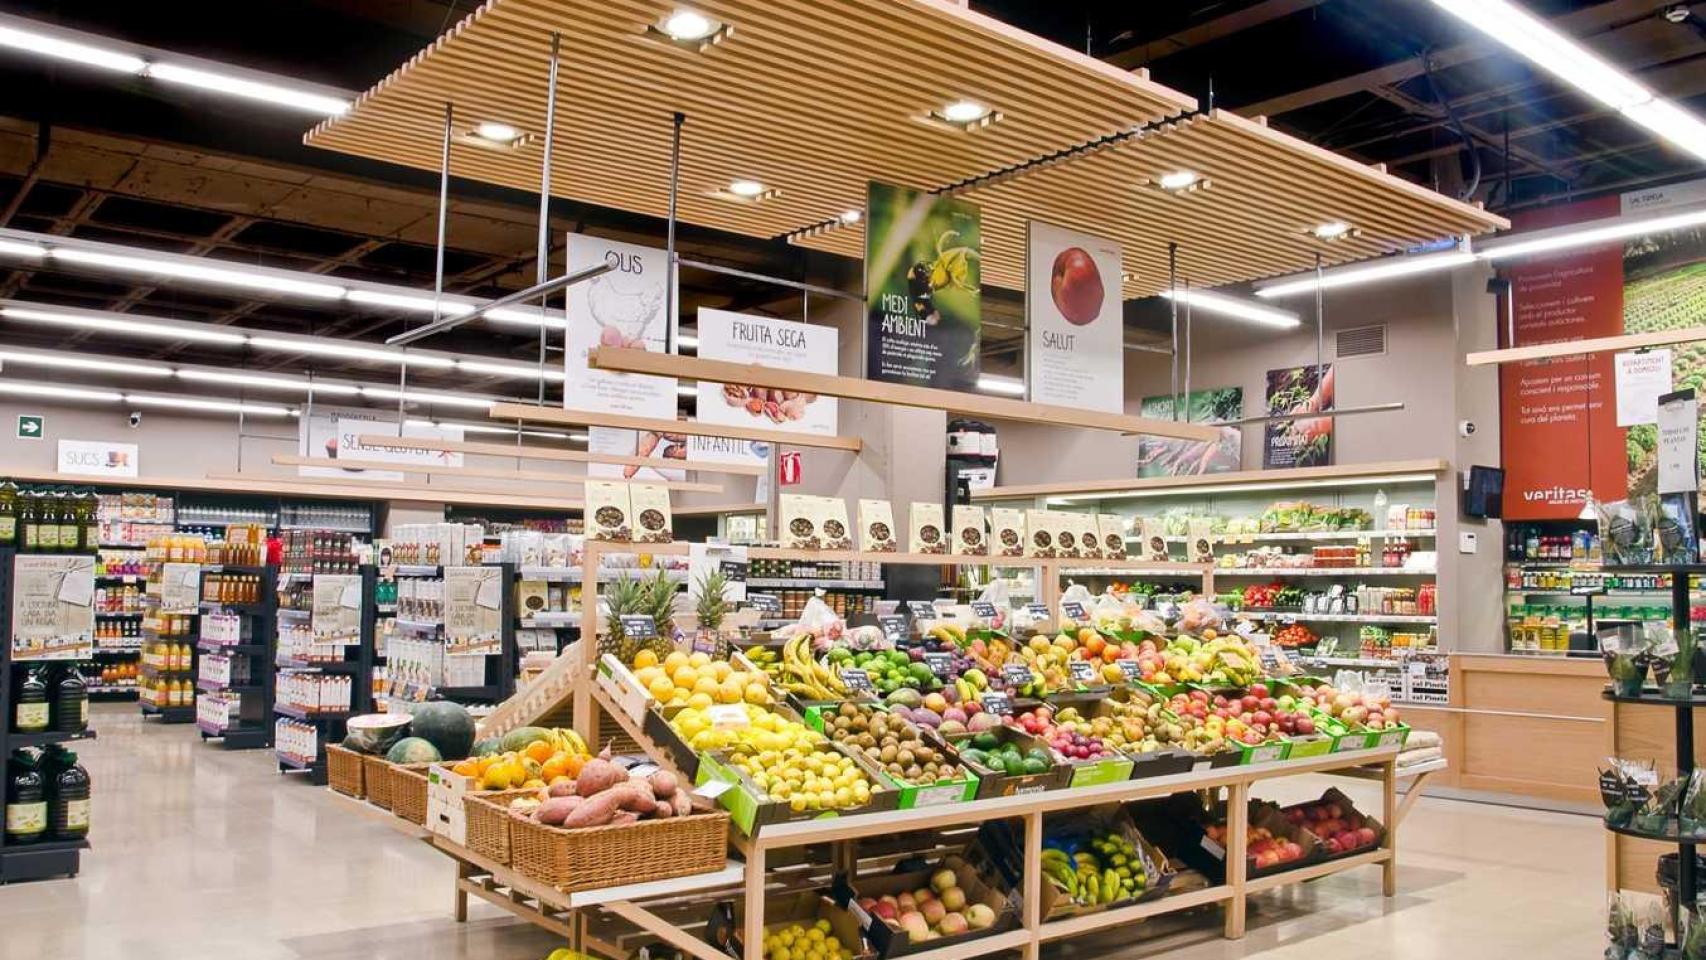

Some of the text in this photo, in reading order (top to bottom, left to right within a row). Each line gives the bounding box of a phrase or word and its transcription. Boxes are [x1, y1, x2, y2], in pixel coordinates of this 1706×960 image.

[605, 250, 643, 274] OUS
[882, 293, 908, 315] MEDI
[732, 322, 773, 345] FRUITA
[776, 329, 807, 349] SECA
[881, 314, 928, 339] AMBIENT
[1042, 330, 1076, 351] SALUT
[66, 450, 100, 466] SUCS
[1523, 486, 1588, 501] veritas
